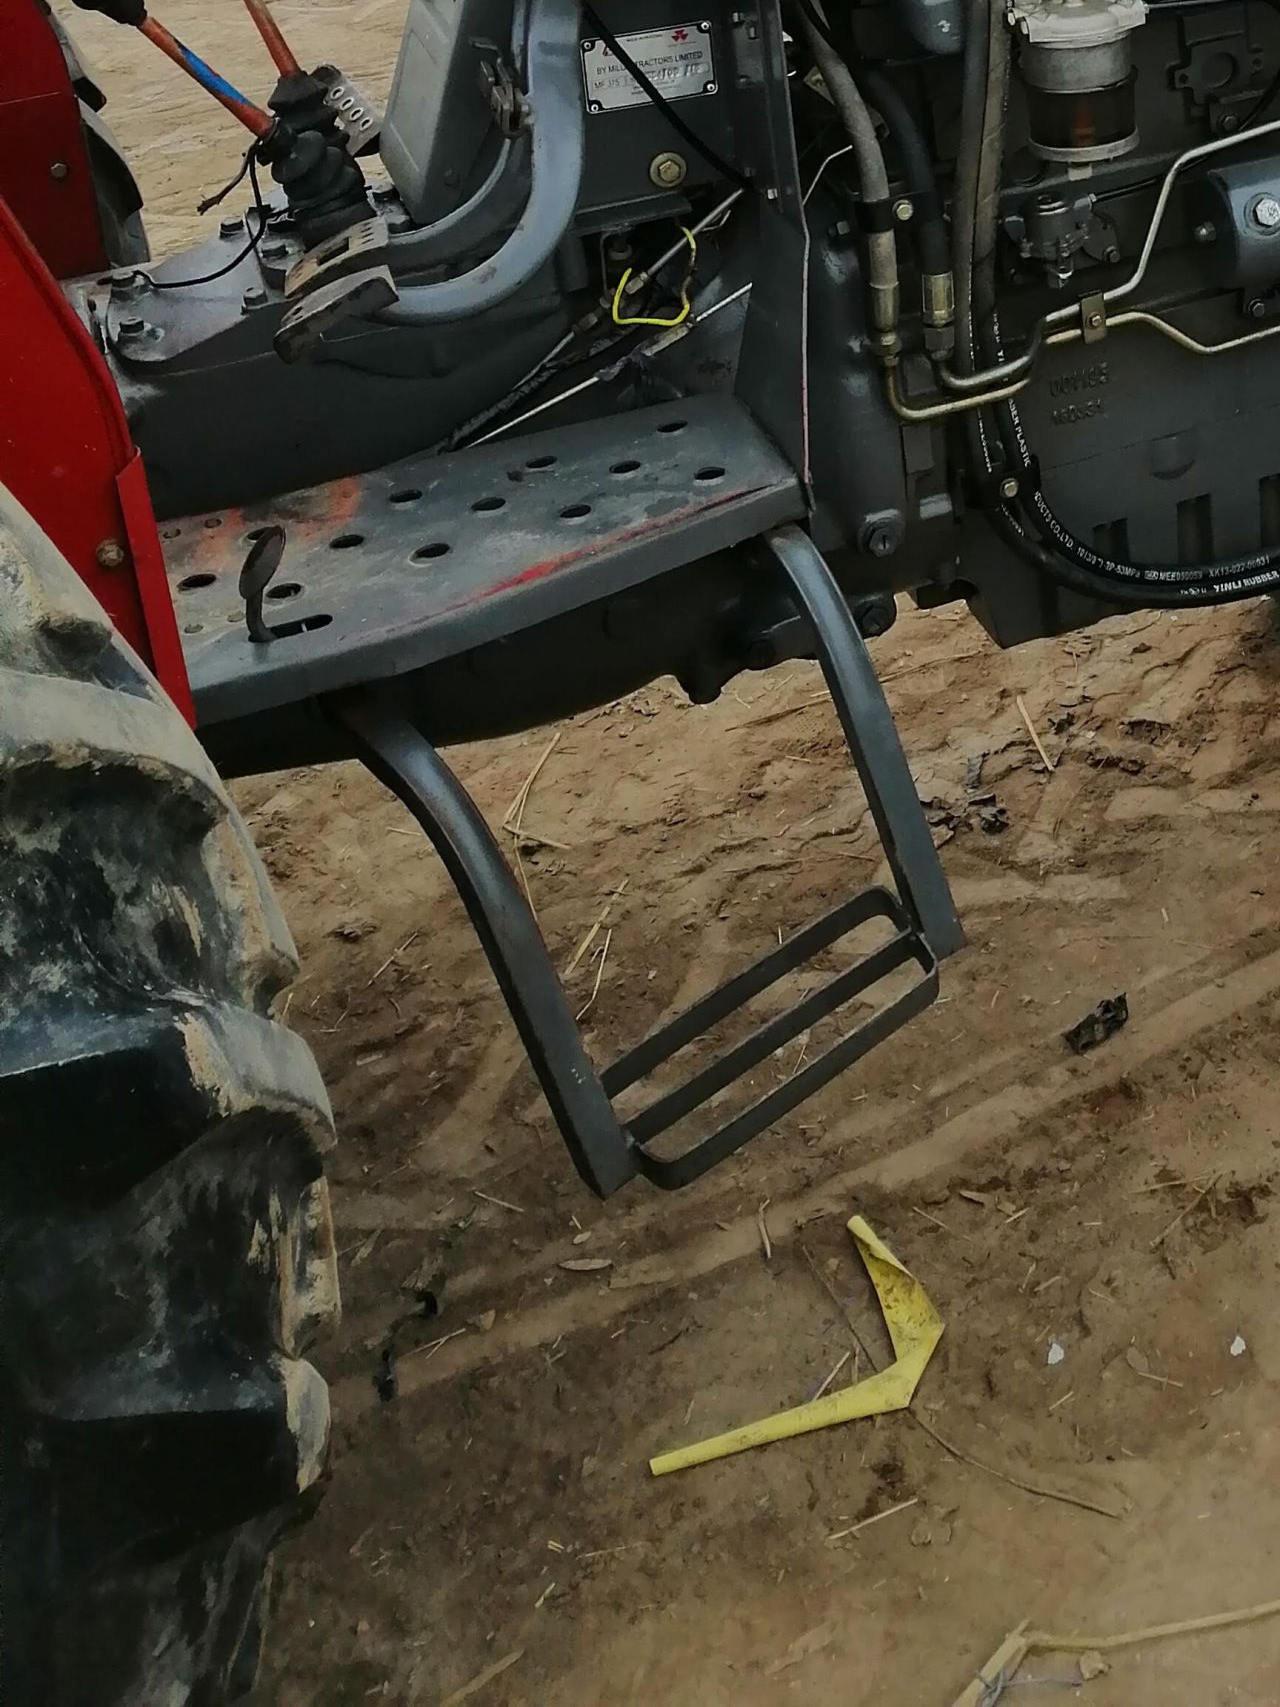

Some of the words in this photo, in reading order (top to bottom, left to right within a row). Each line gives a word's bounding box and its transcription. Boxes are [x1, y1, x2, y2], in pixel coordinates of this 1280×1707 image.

[596, 66, 607, 75] BY
[674, 51, 703, 63] LIMITED
[1243, 570, 1279, 588] RUBBER
